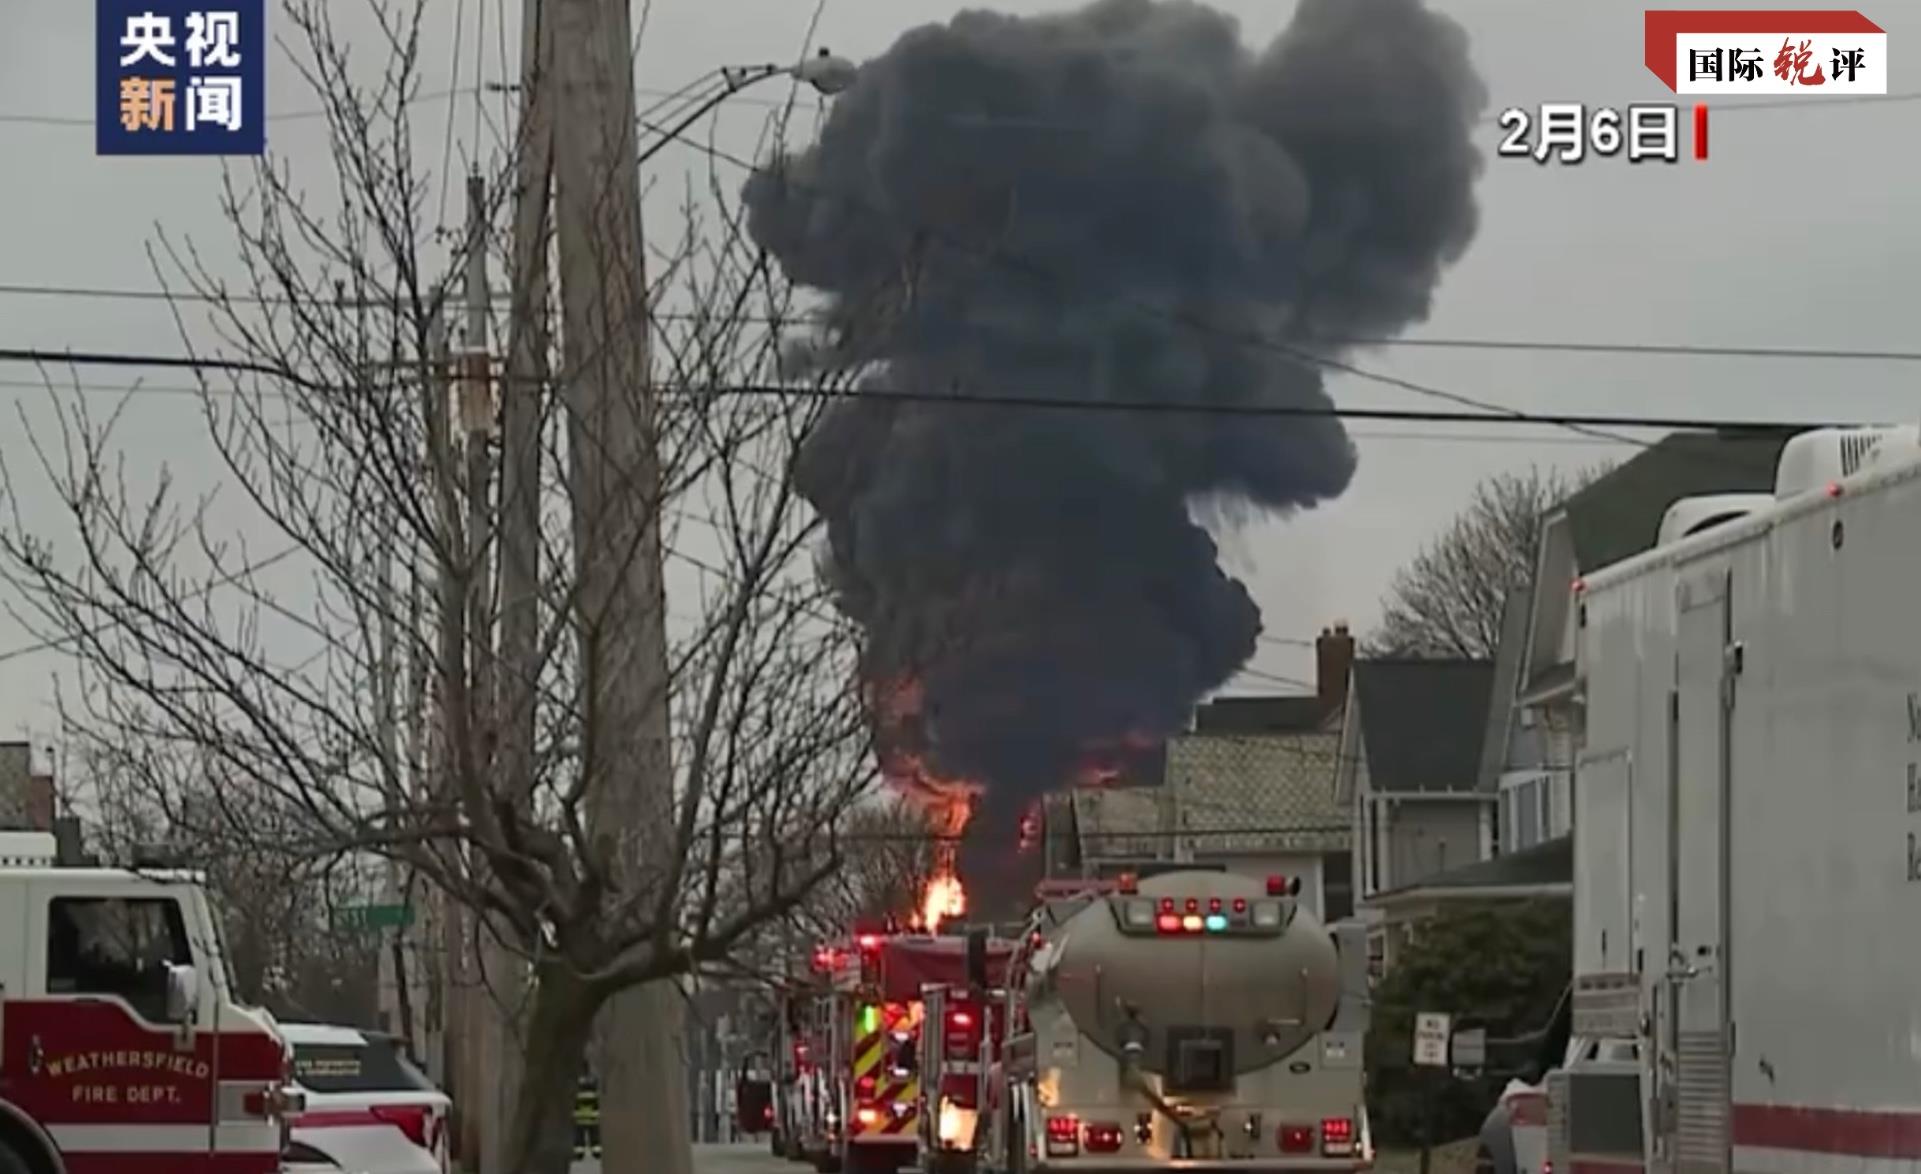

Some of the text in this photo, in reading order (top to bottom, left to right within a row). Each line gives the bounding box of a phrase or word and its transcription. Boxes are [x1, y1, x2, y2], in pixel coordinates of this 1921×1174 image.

[46, 1050, 210, 1079] WEATHERSFIELD
[72, 1086, 182, 1103] FIRE DEPT.
